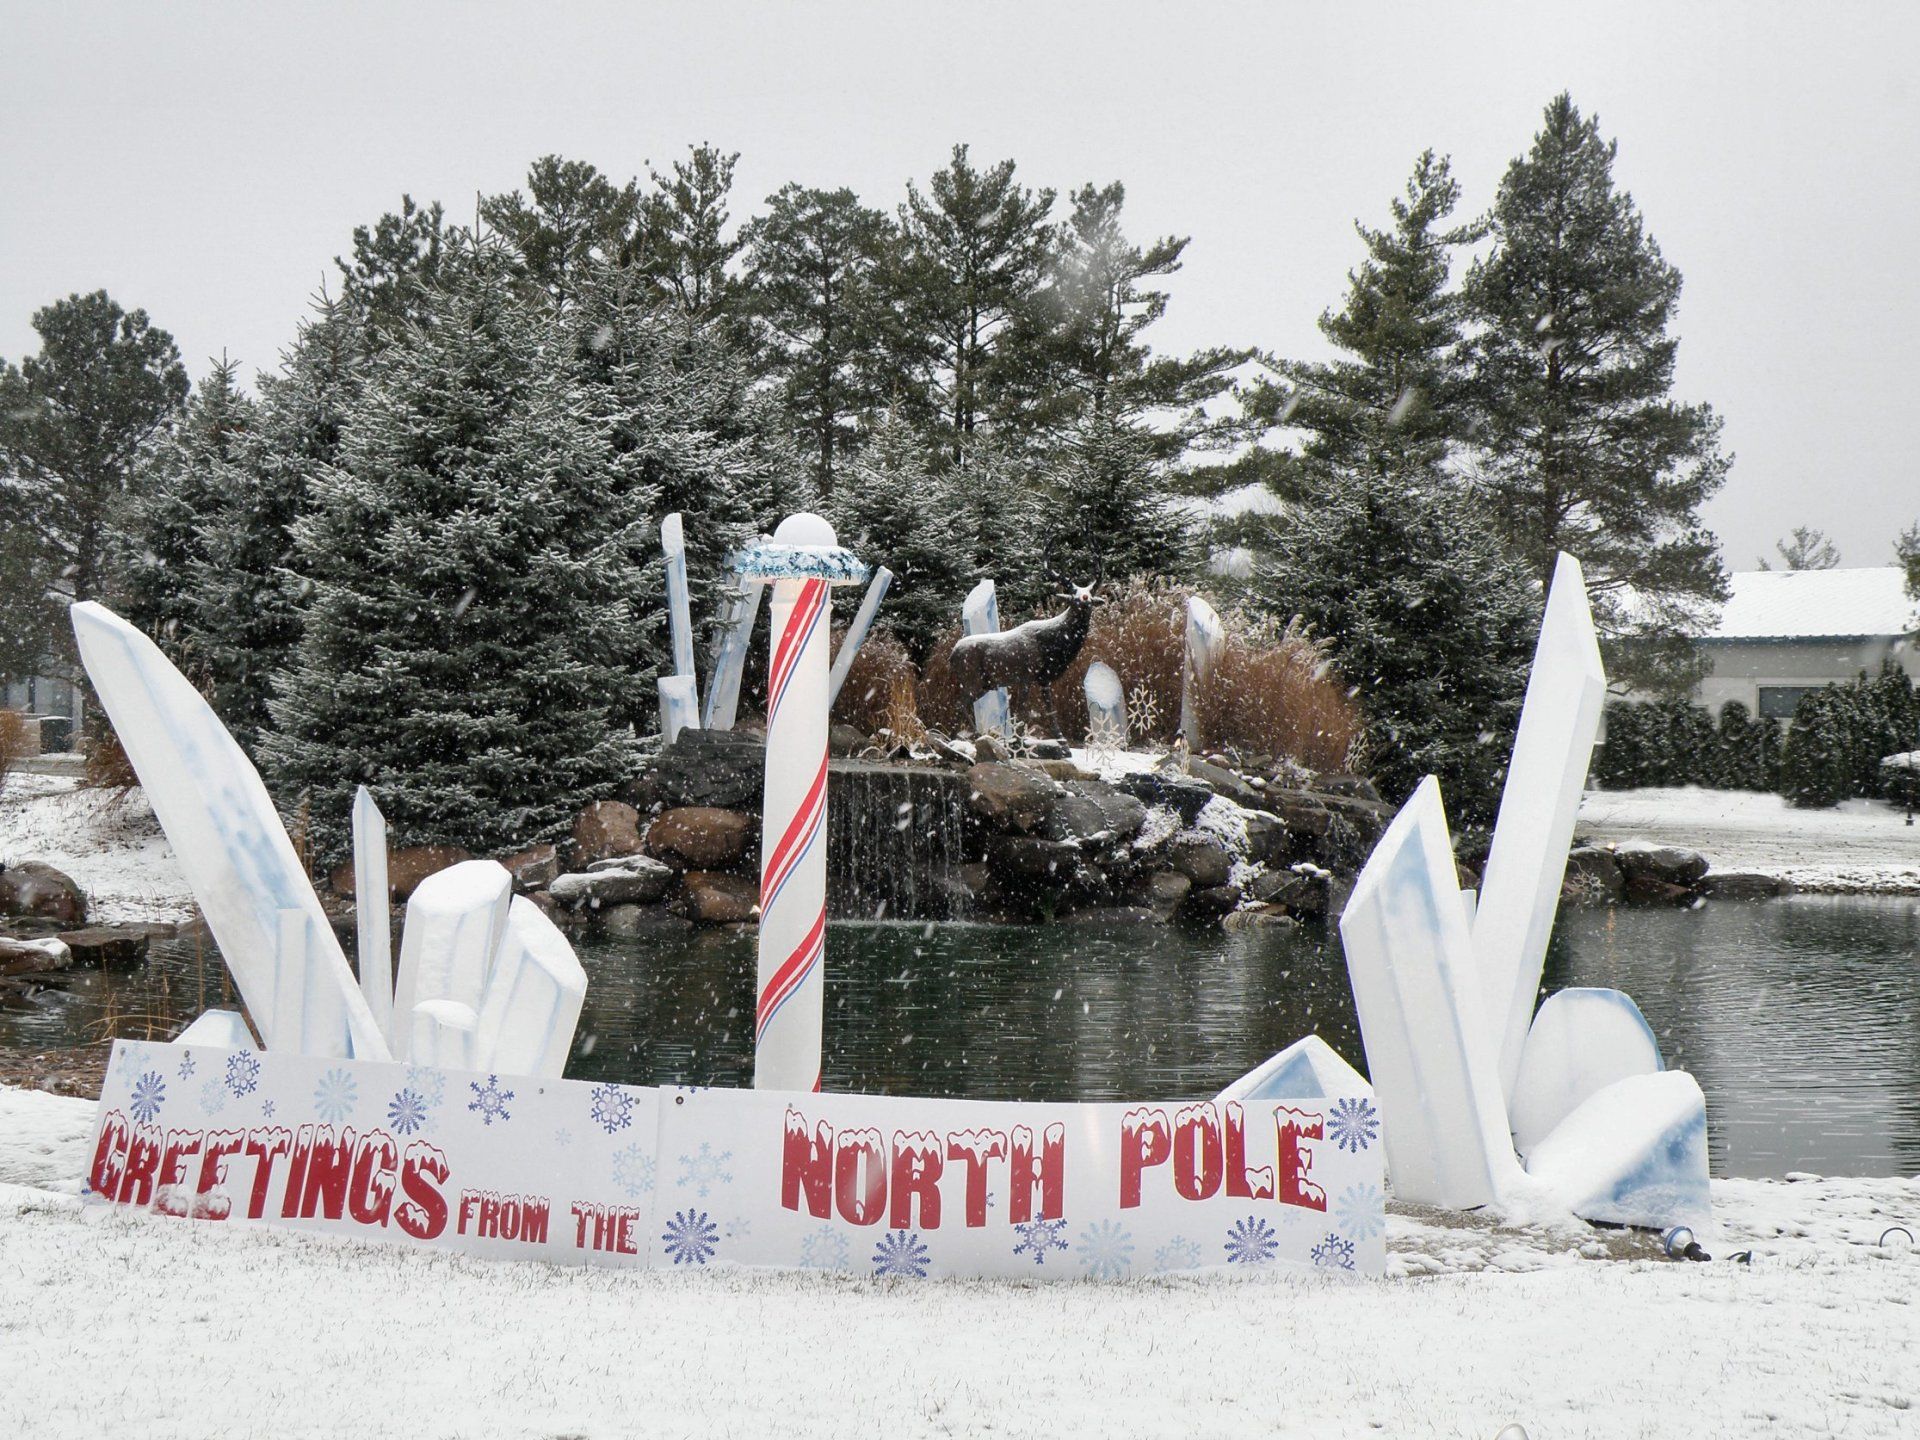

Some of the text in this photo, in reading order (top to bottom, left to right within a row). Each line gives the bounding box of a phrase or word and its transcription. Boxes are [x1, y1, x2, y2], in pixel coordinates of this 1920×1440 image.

[90, 1101, 1327, 1255] GREETINGS FROM THE NORTH POLE
